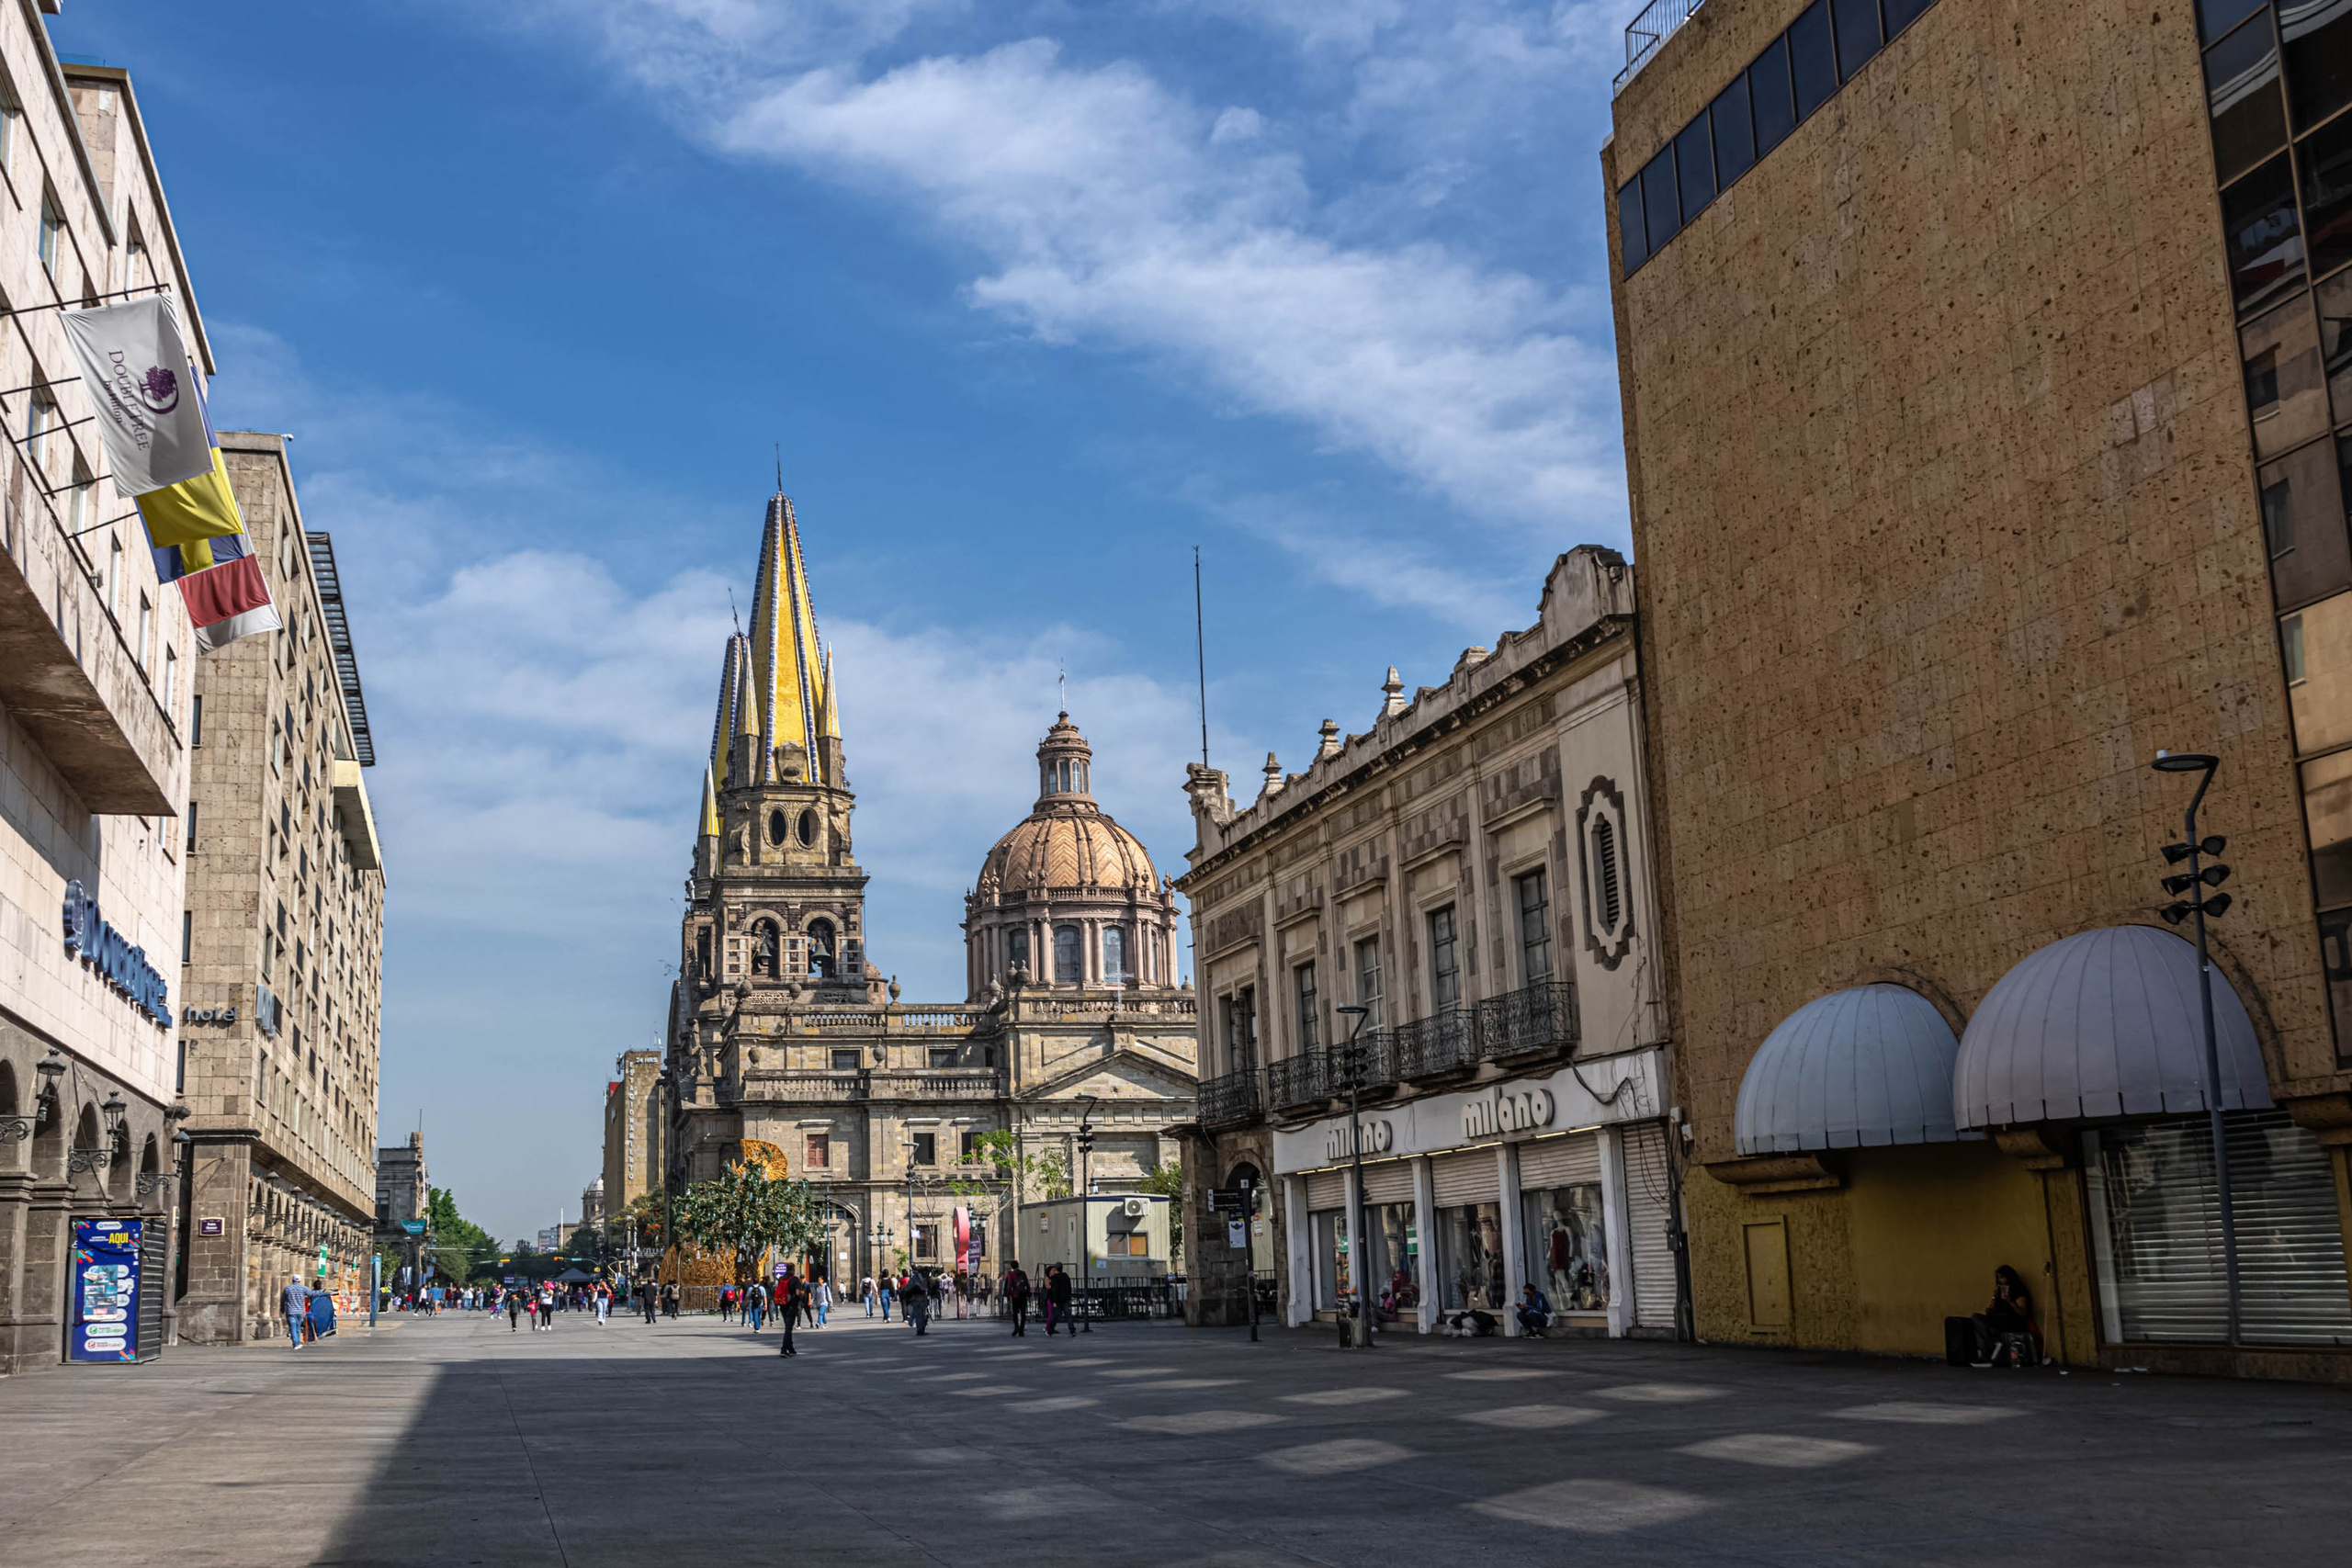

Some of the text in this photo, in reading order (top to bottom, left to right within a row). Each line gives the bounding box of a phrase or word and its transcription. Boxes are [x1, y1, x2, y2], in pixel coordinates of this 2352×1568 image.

[108, 351, 150, 451] DOUBLETREE
[187, 1004, 238, 1021] hotel
[1460, 1086, 1555, 1139] milano
